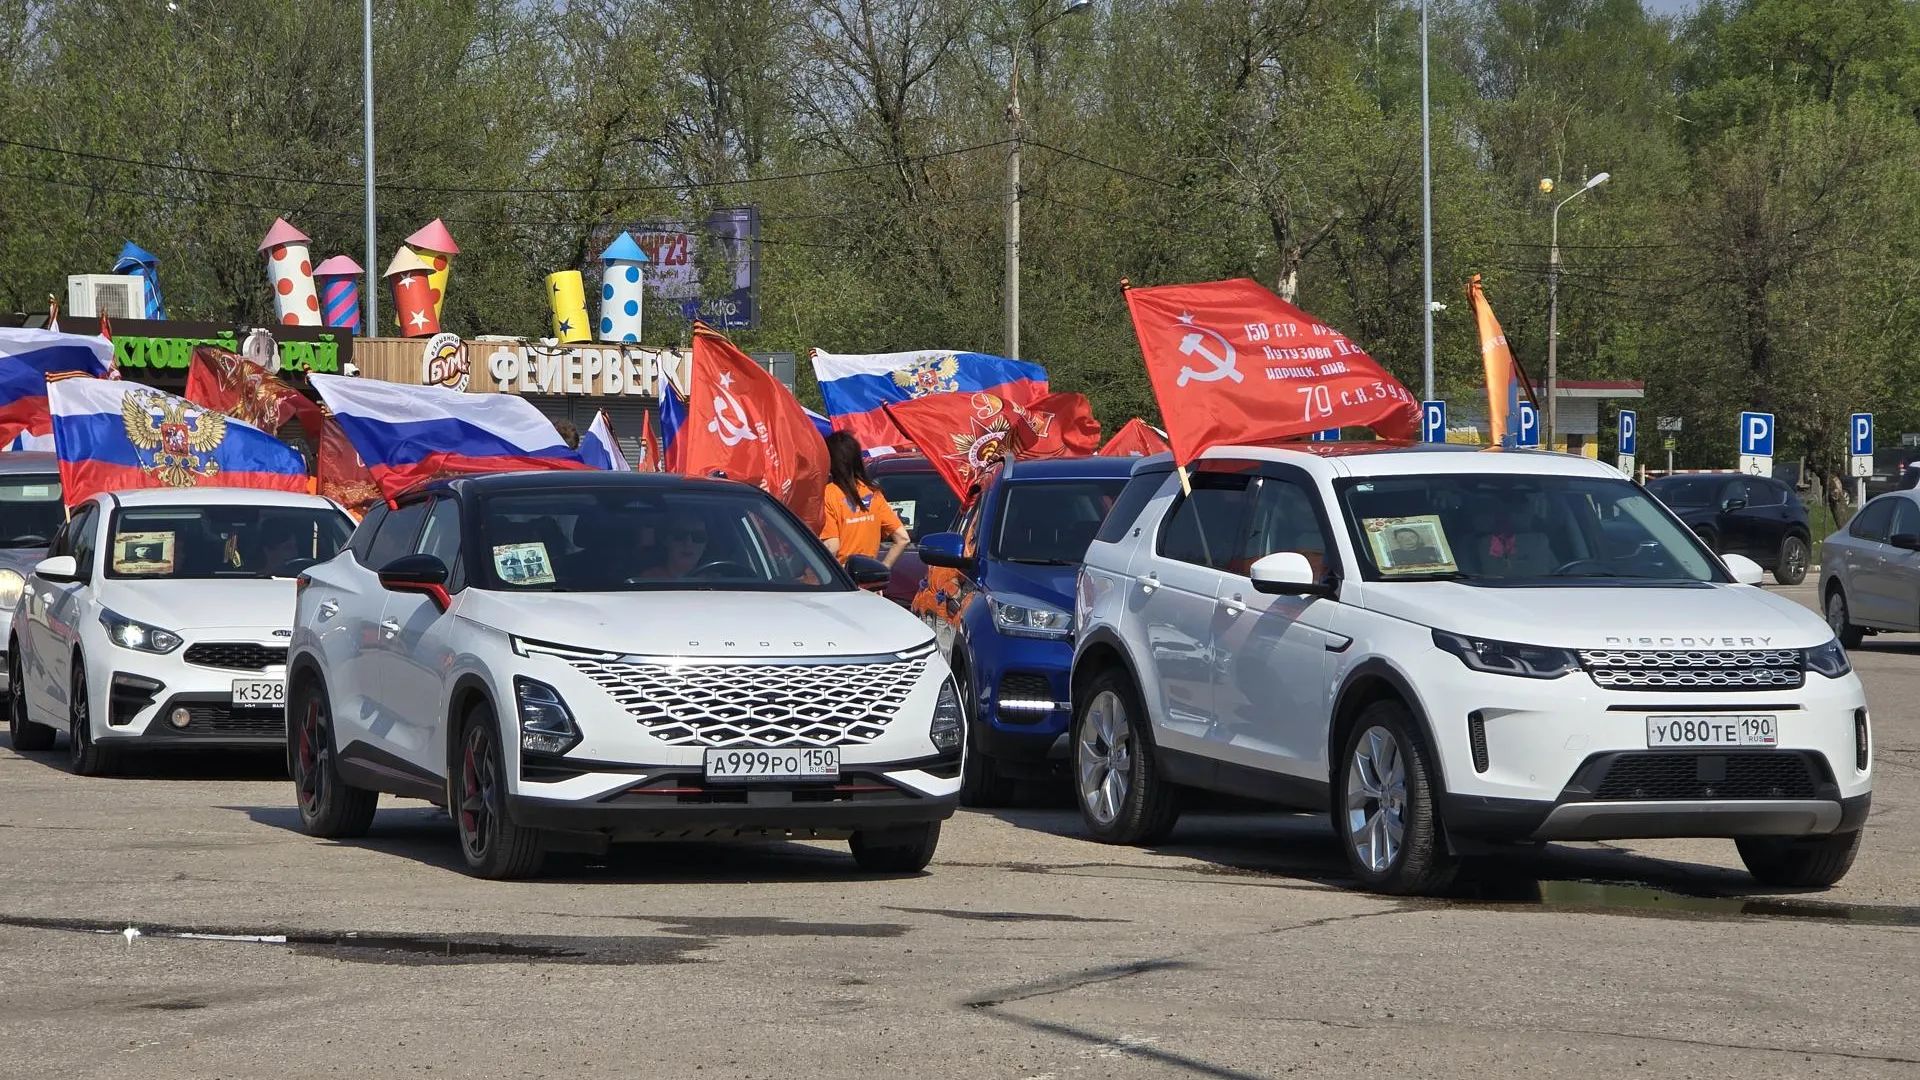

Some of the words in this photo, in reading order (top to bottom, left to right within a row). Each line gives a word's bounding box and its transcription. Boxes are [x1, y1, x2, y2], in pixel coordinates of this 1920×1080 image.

[1244, 323, 1270, 342] 150
[1274, 323, 1304, 338] СТР.
[279, 334, 338, 372] РАЙ
[430, 344, 468, 383] БУМ!
[488, 338, 693, 397] ФЕЙЕРВЕРК
[1428, 406, 1442, 442] P
[1521, 406, 1535, 441] P
[1623, 416, 1632, 449] P
[1750, 418, 1768, 450] P
[1857, 419, 1869, 450] P
[1605, 636, 1772, 648] DISCOVERY
[1741, 719, 1770, 736] 190
[803, 750, 834, 767] 150
